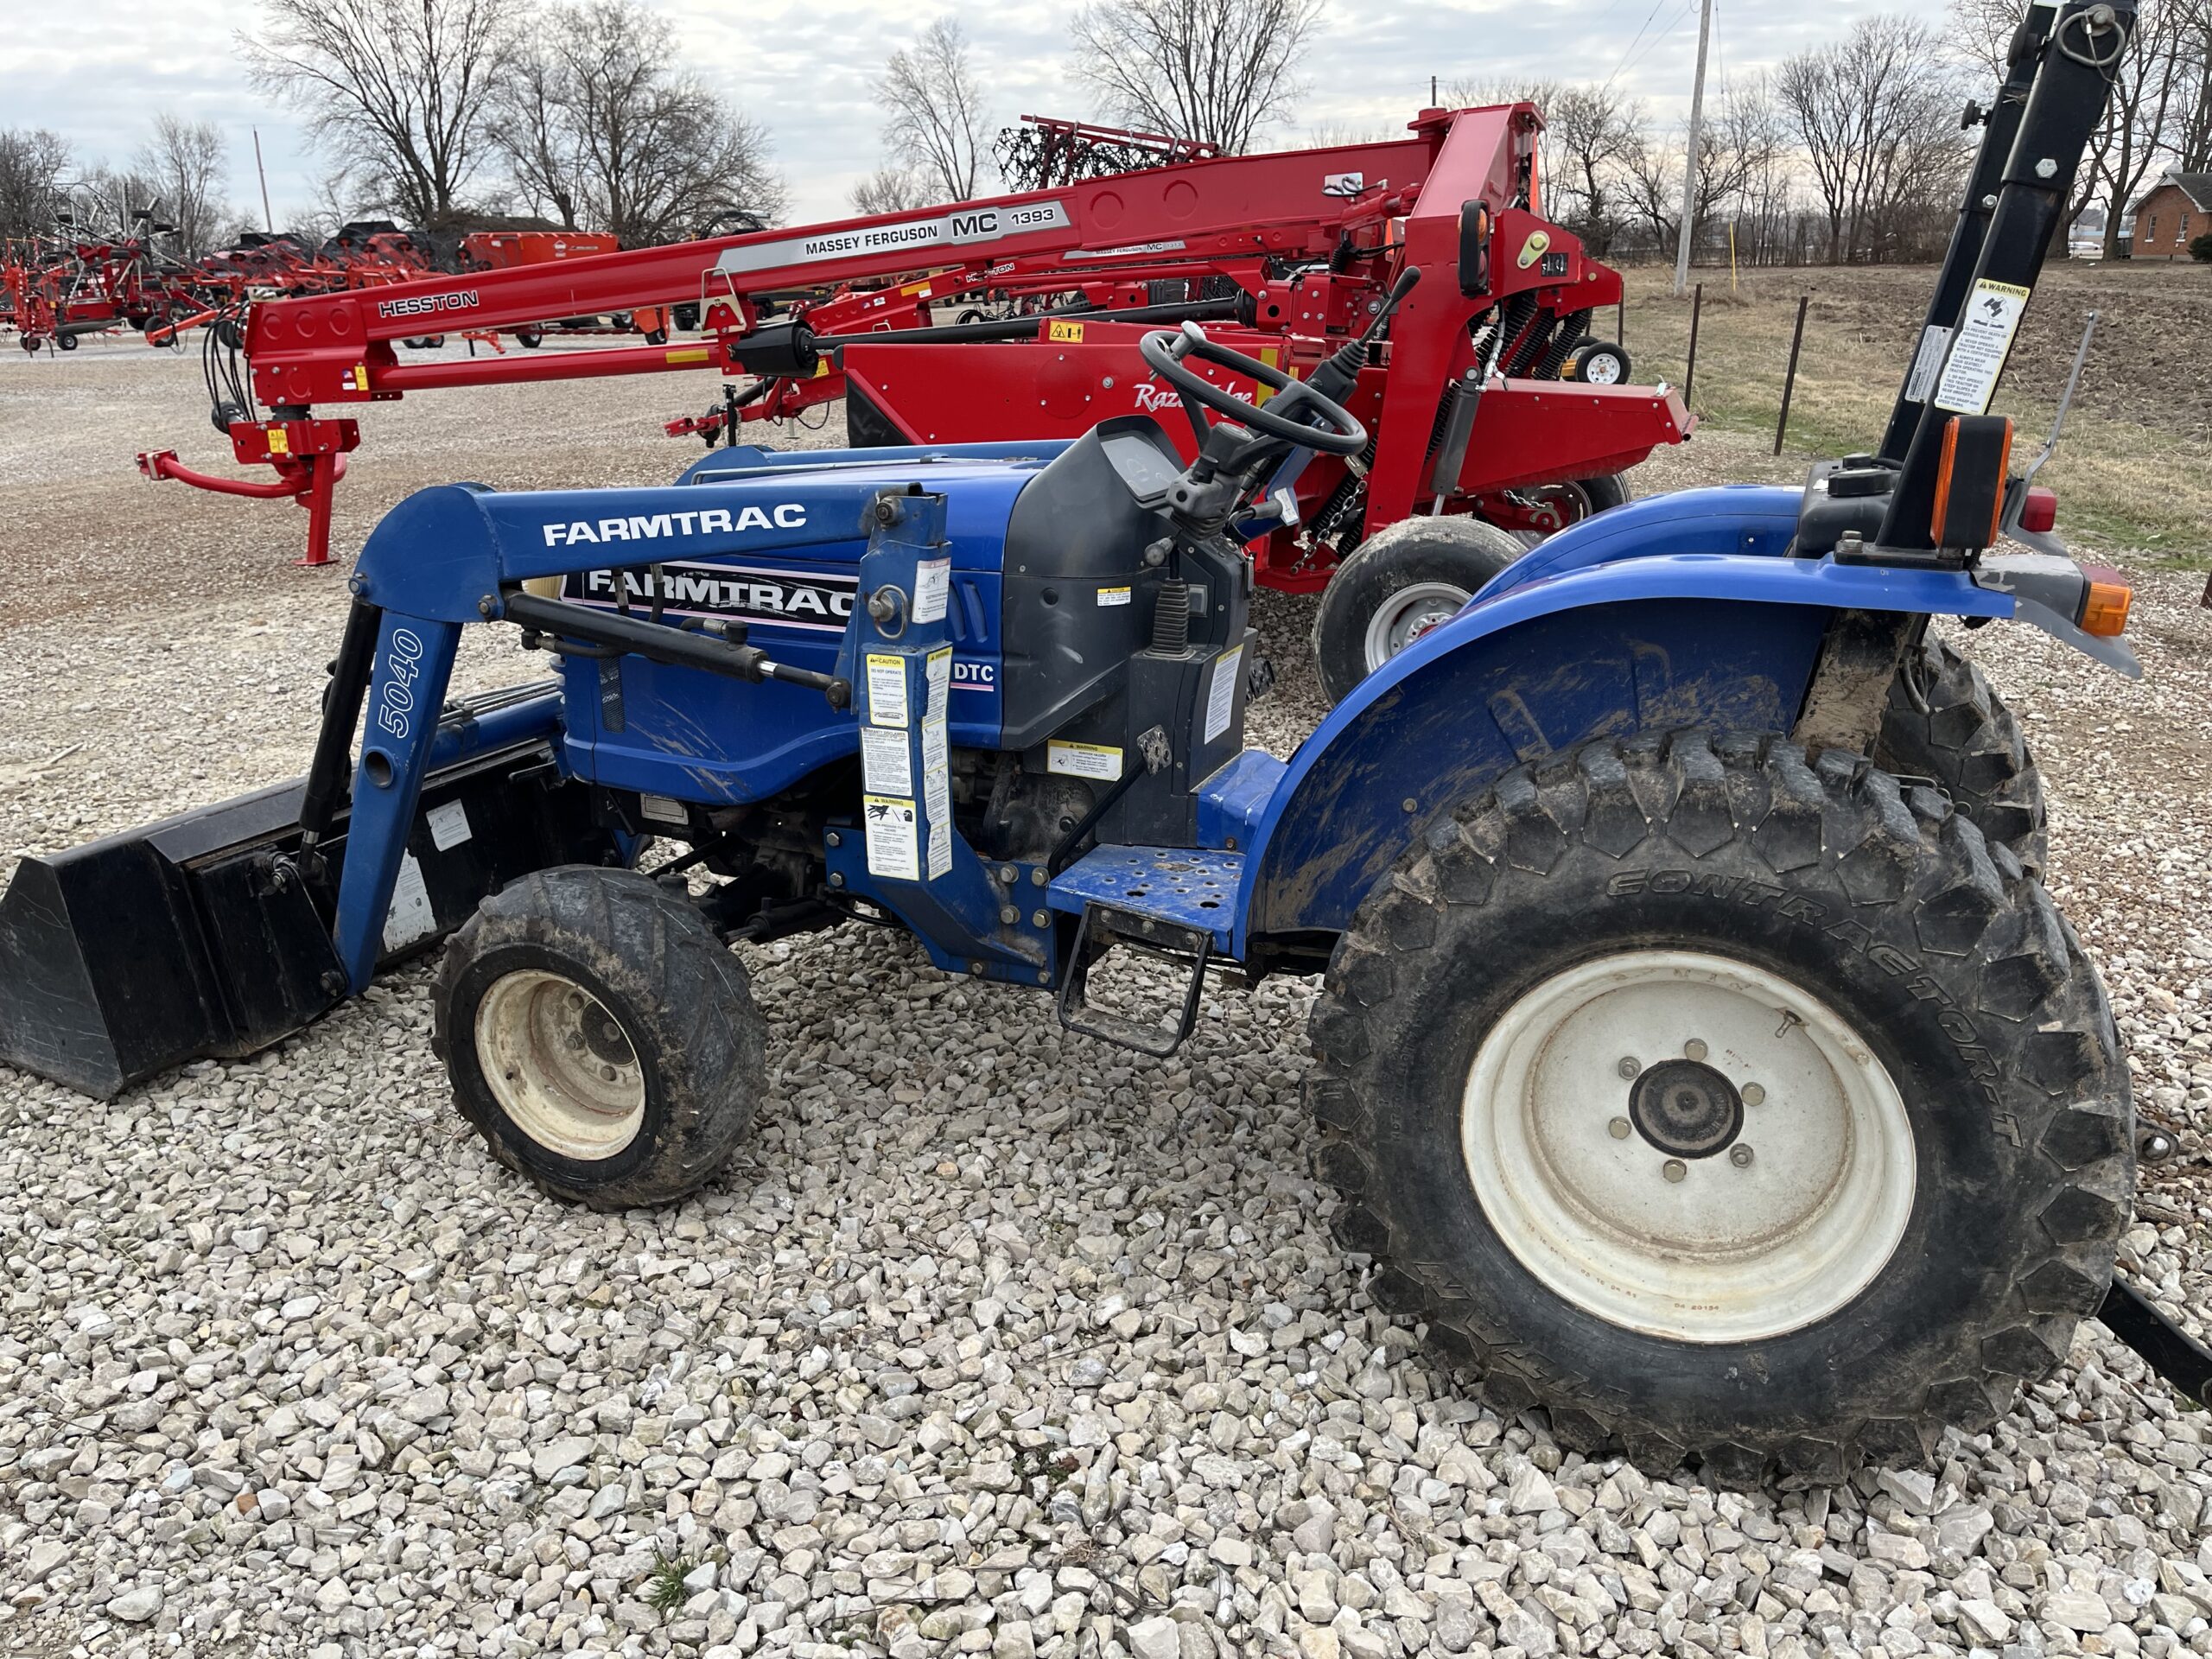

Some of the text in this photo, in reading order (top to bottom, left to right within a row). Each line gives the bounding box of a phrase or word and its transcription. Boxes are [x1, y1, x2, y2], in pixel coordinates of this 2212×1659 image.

[805, 207, 1055, 256] MASSEY FERGUSON MC 1393
[966, 263, 1015, 283] HTON
[378, 290, 479, 318] HESSTON
[1988, 283, 2027, 297] WARNING
[543, 504, 806, 547] FARMTRAC
[378, 628, 423, 739] 5040
[954, 663, 994, 682] DTC
